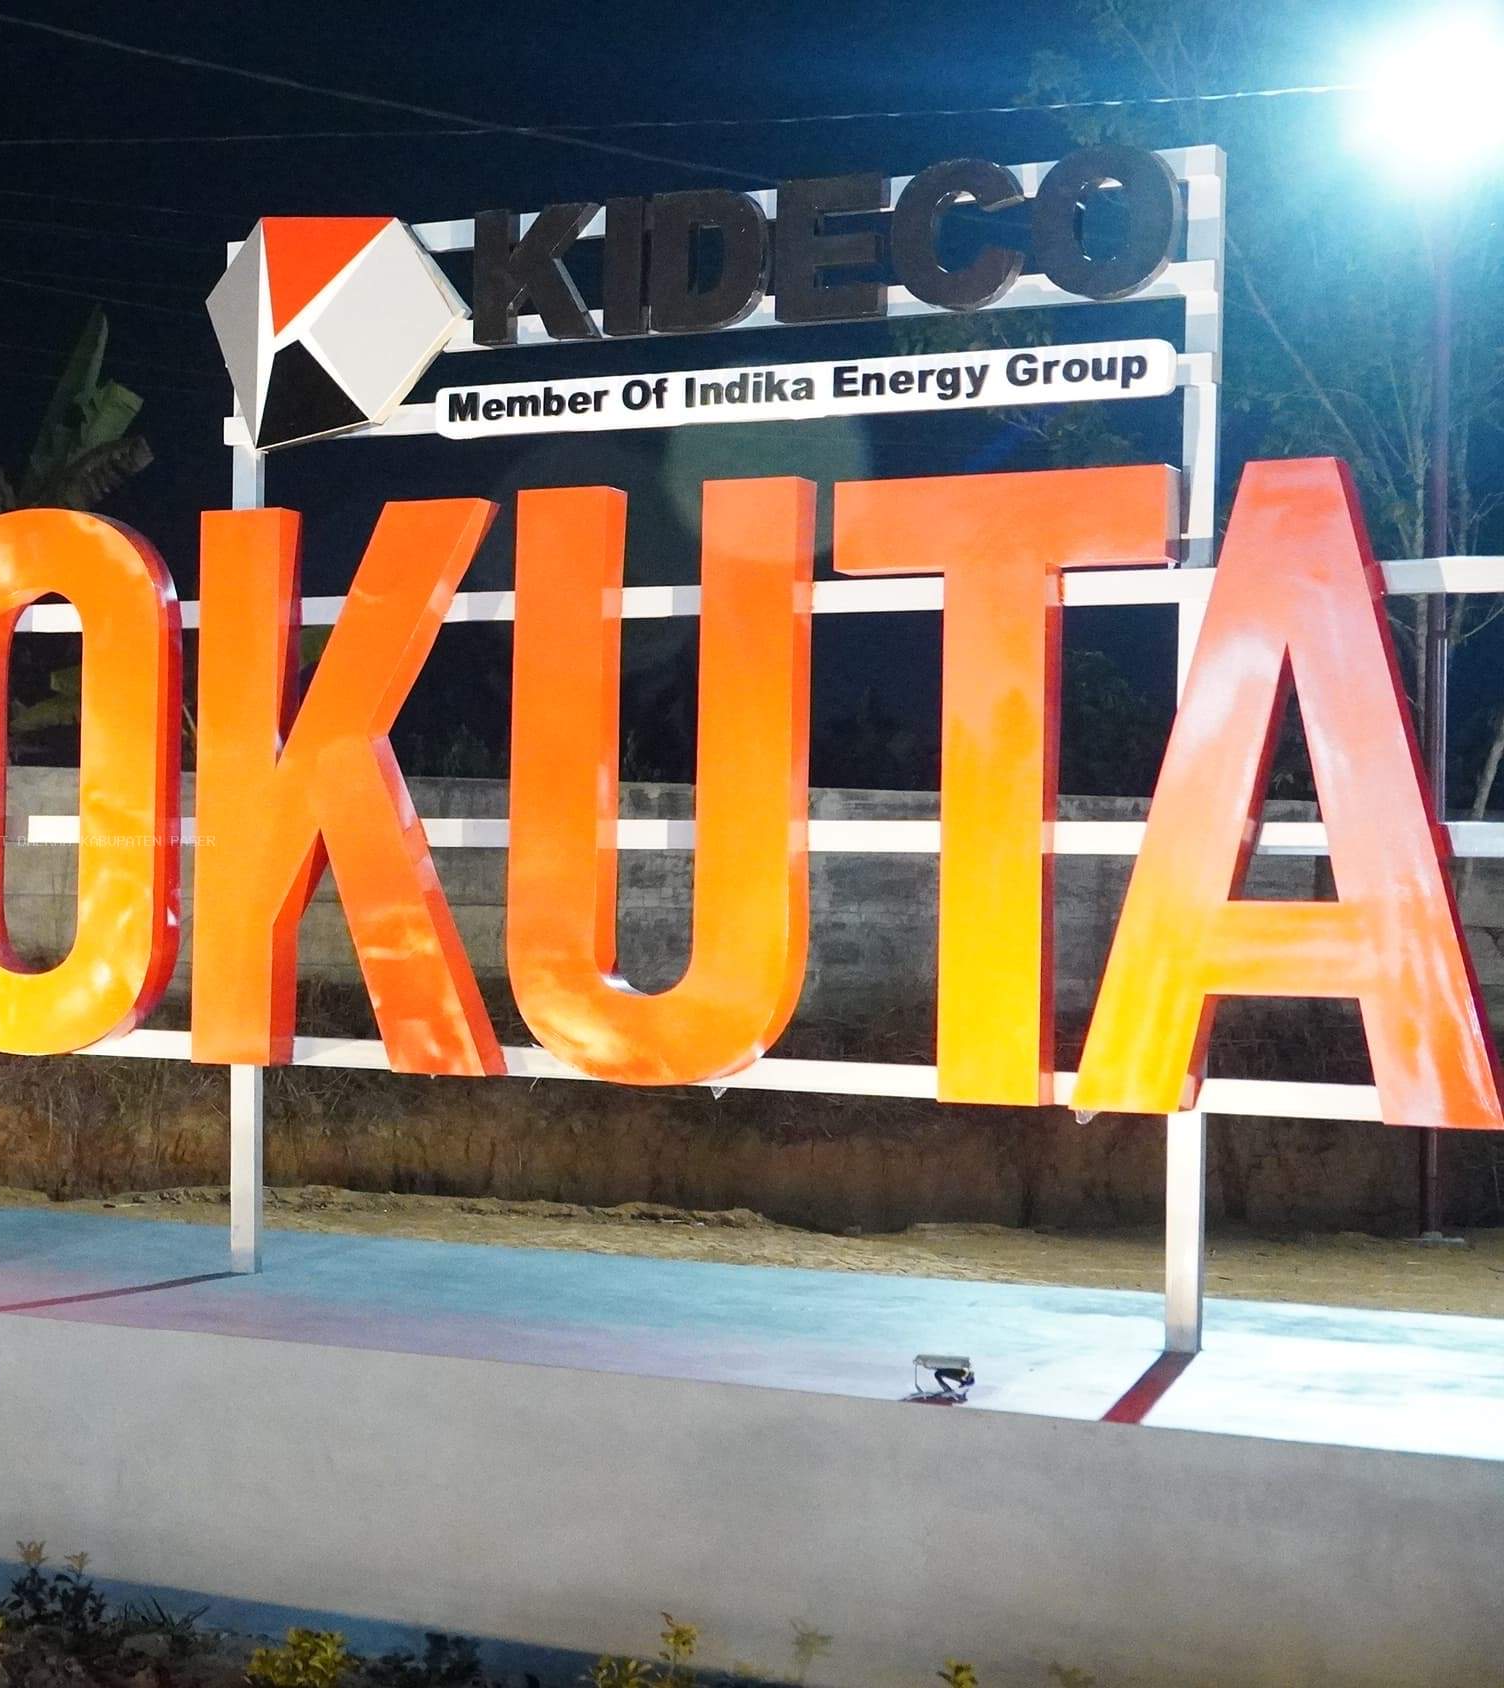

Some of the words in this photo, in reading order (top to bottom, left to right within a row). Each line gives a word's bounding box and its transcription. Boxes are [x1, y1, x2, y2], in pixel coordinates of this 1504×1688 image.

[474, 149, 1180, 345] KIDECO
[448, 387, 609, 422] Member
[622, 377, 668, 410] Of
[685, 371, 815, 408] Indika
[833, 365, 989, 400] Energy
[1006, 353, 1148, 389] Group
